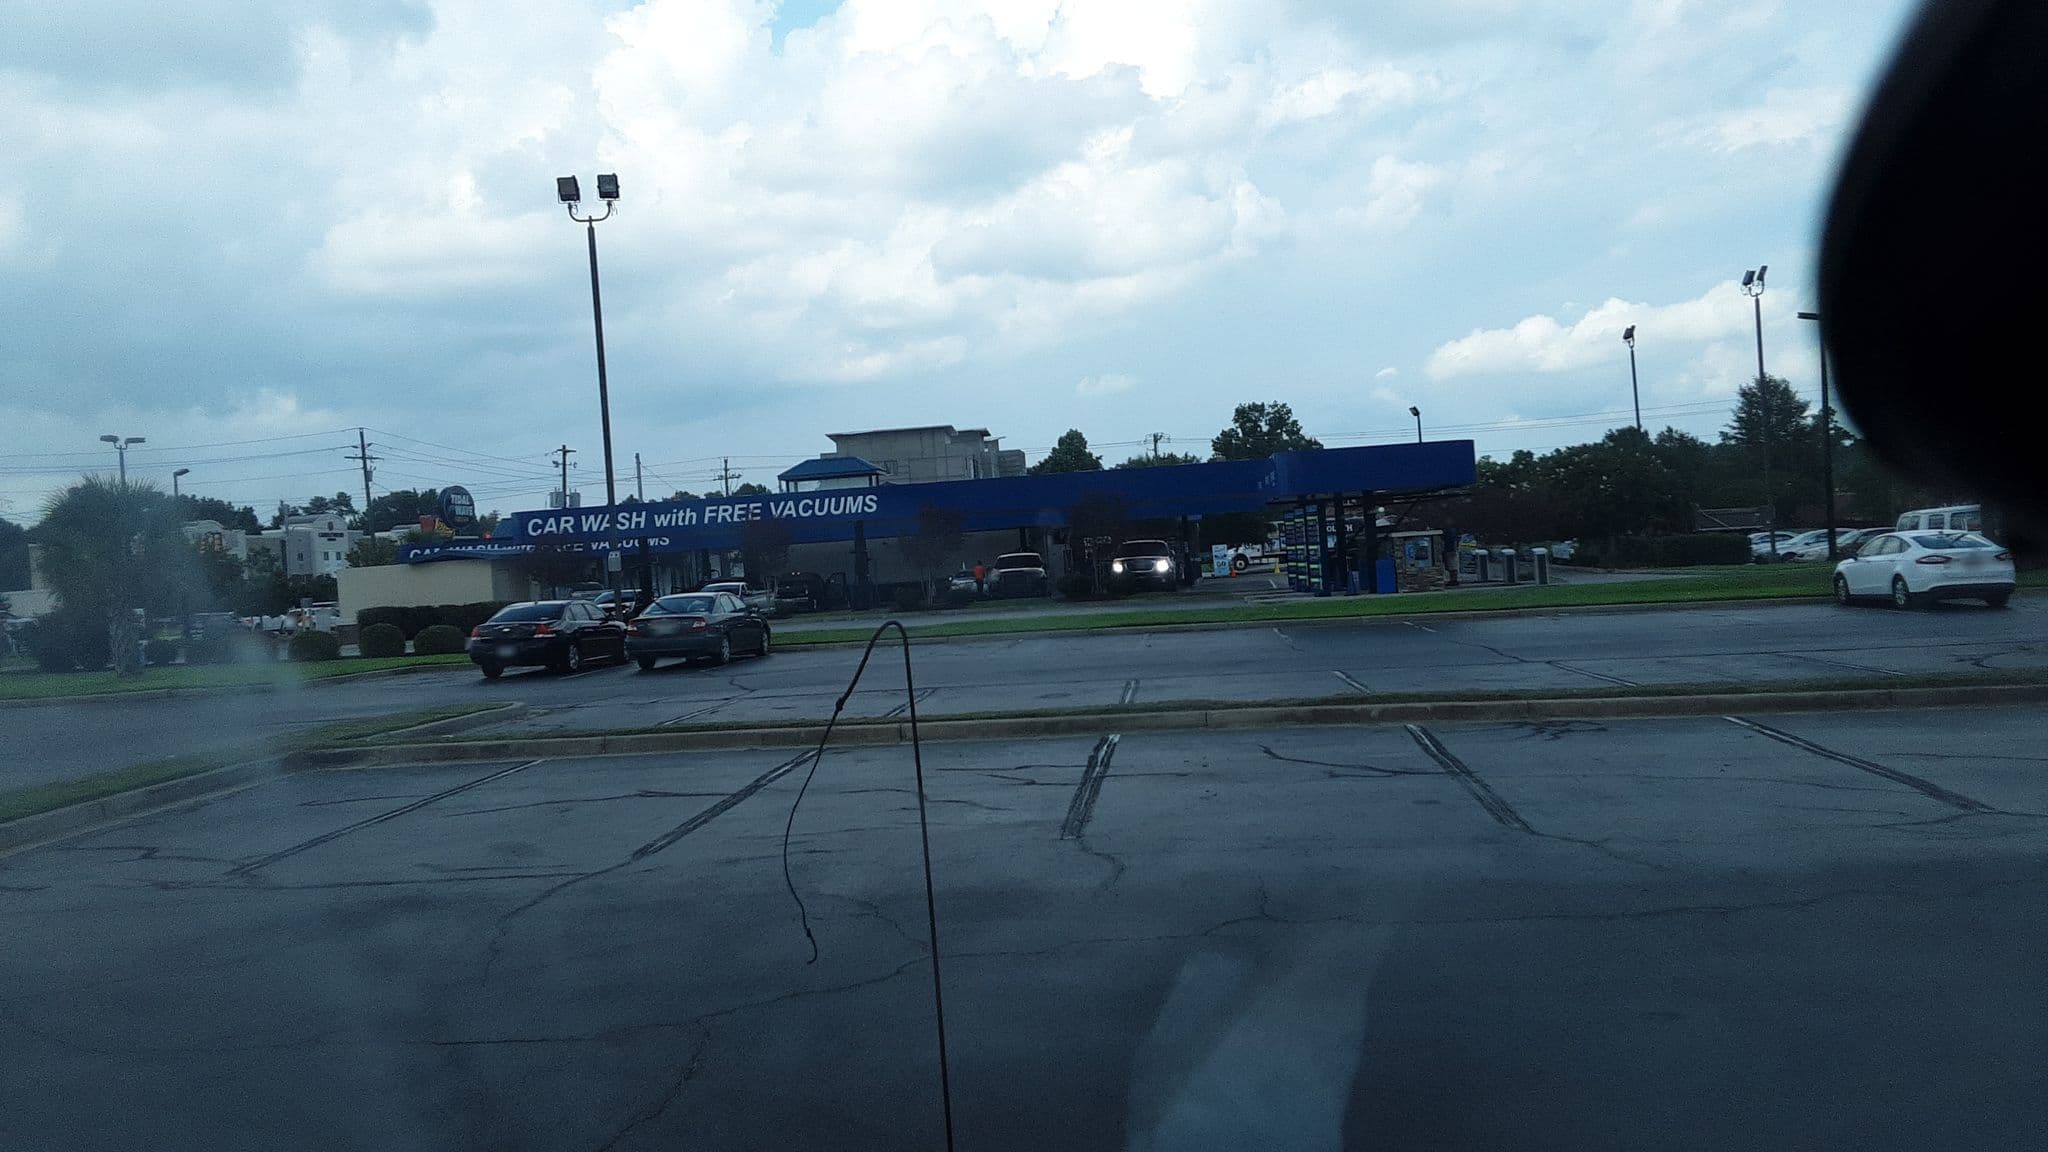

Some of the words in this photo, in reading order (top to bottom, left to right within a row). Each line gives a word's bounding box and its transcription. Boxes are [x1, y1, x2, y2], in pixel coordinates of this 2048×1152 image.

[527, 516, 575, 537] CAR
[581, 511, 647, 533] WASH
[654, 508, 697, 527] with
[703, 503, 763, 524] FREE
[770, 494, 878, 518] VACUUMS
